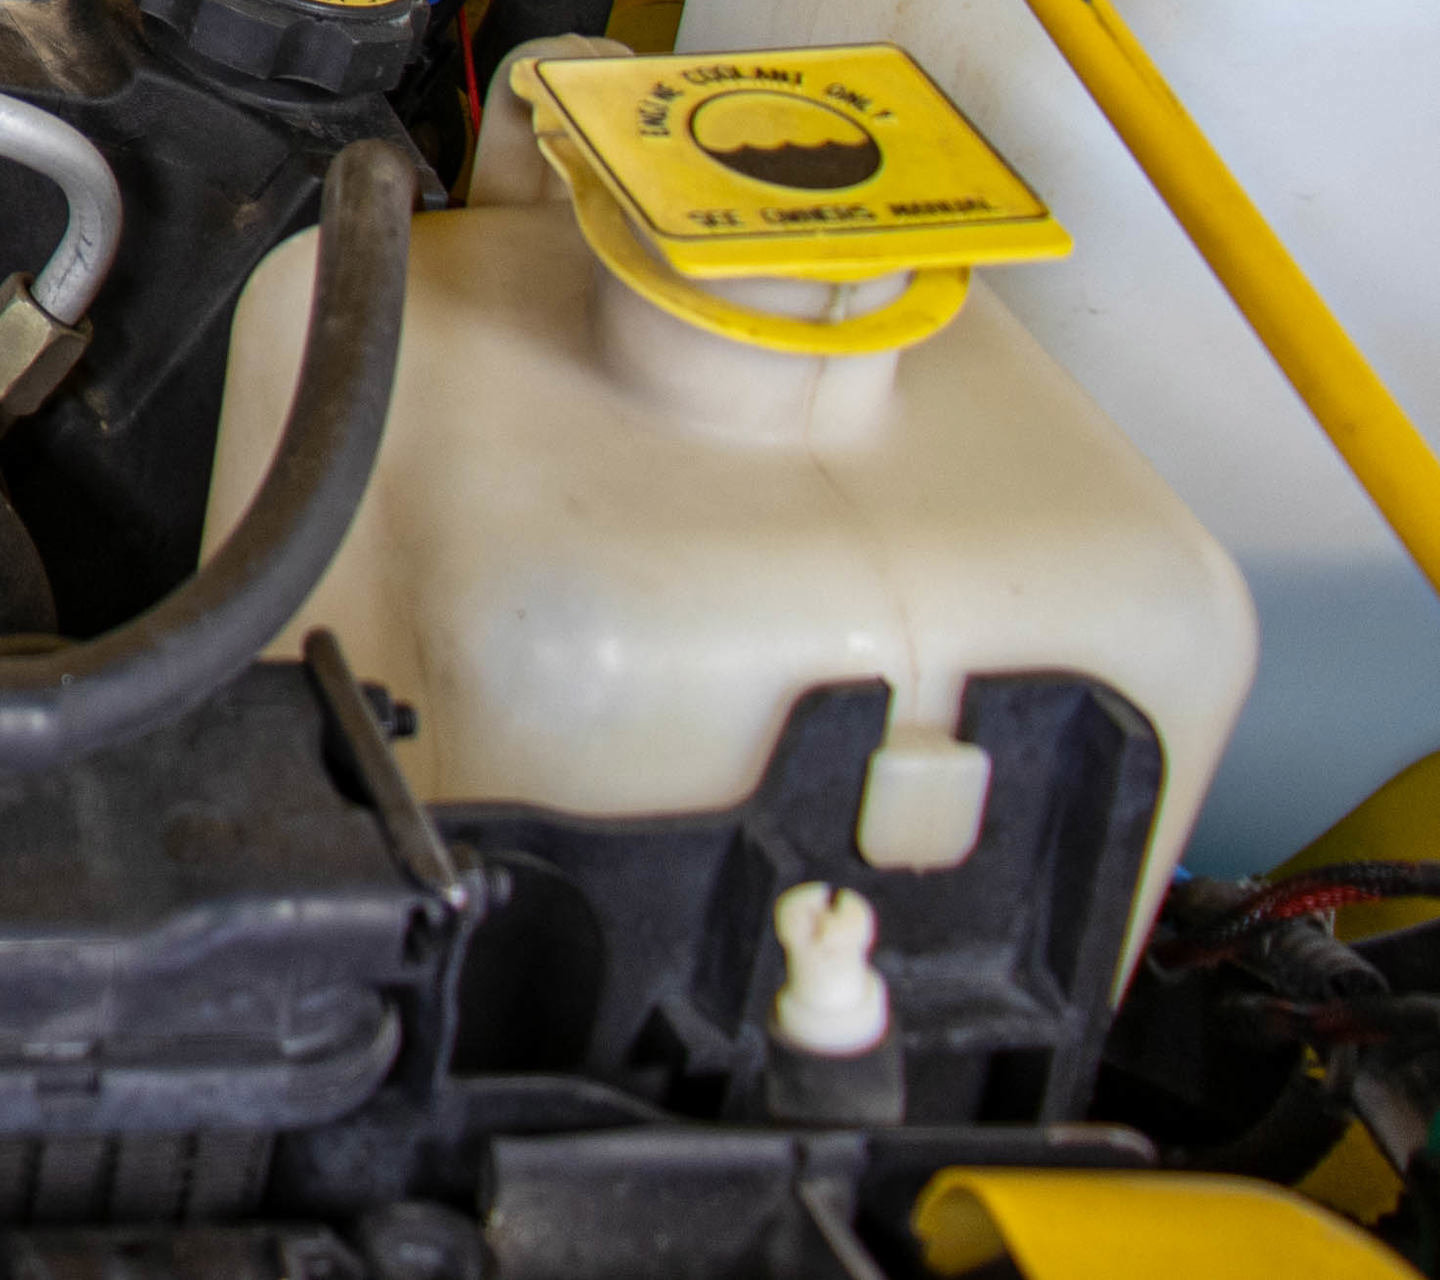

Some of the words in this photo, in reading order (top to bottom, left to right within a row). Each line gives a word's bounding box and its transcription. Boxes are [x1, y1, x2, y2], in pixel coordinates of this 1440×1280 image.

[637, 80, 683, 137] ENGINE
[680, 63, 804, 87] COOLANT
[823, 80, 895, 118] ONLY
[686, 207, 746, 228] SEE
[889, 194, 999, 219] MANUAL
